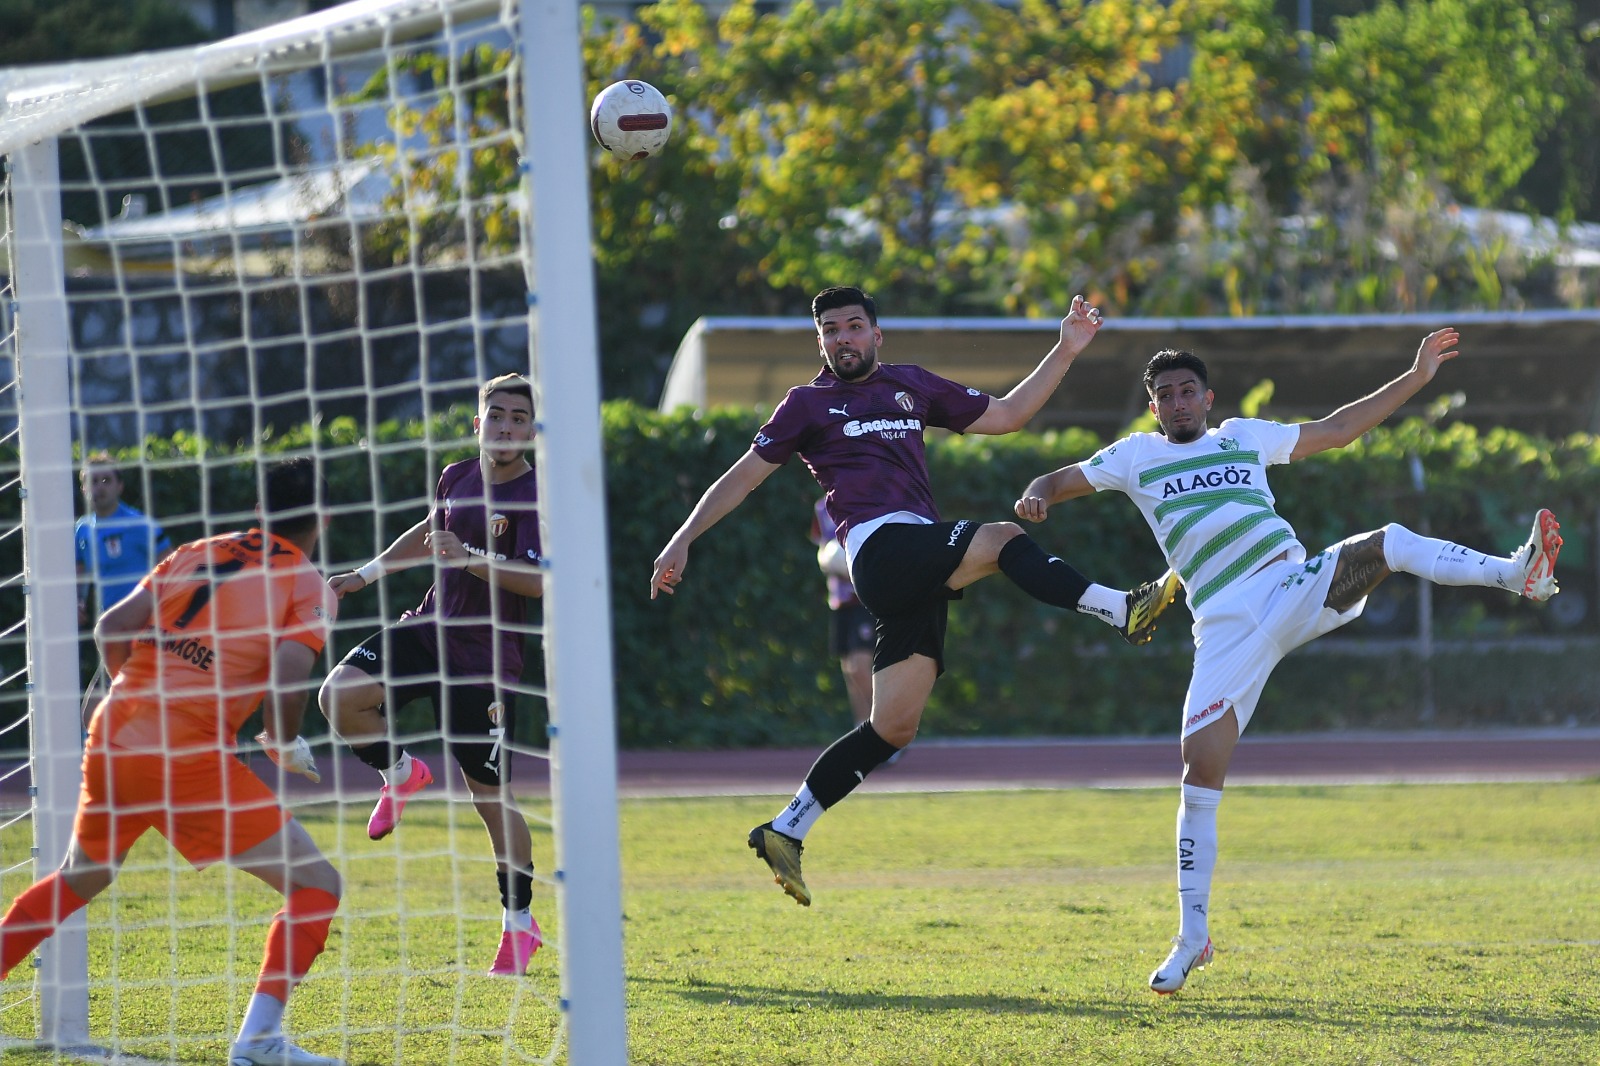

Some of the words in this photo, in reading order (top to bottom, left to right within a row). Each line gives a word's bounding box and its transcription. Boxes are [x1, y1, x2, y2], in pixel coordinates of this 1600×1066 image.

[1162, 465, 1252, 498] ALAGÖZ
[489, 727, 506, 761] 7
[1179, 837, 1195, 871] CAN
